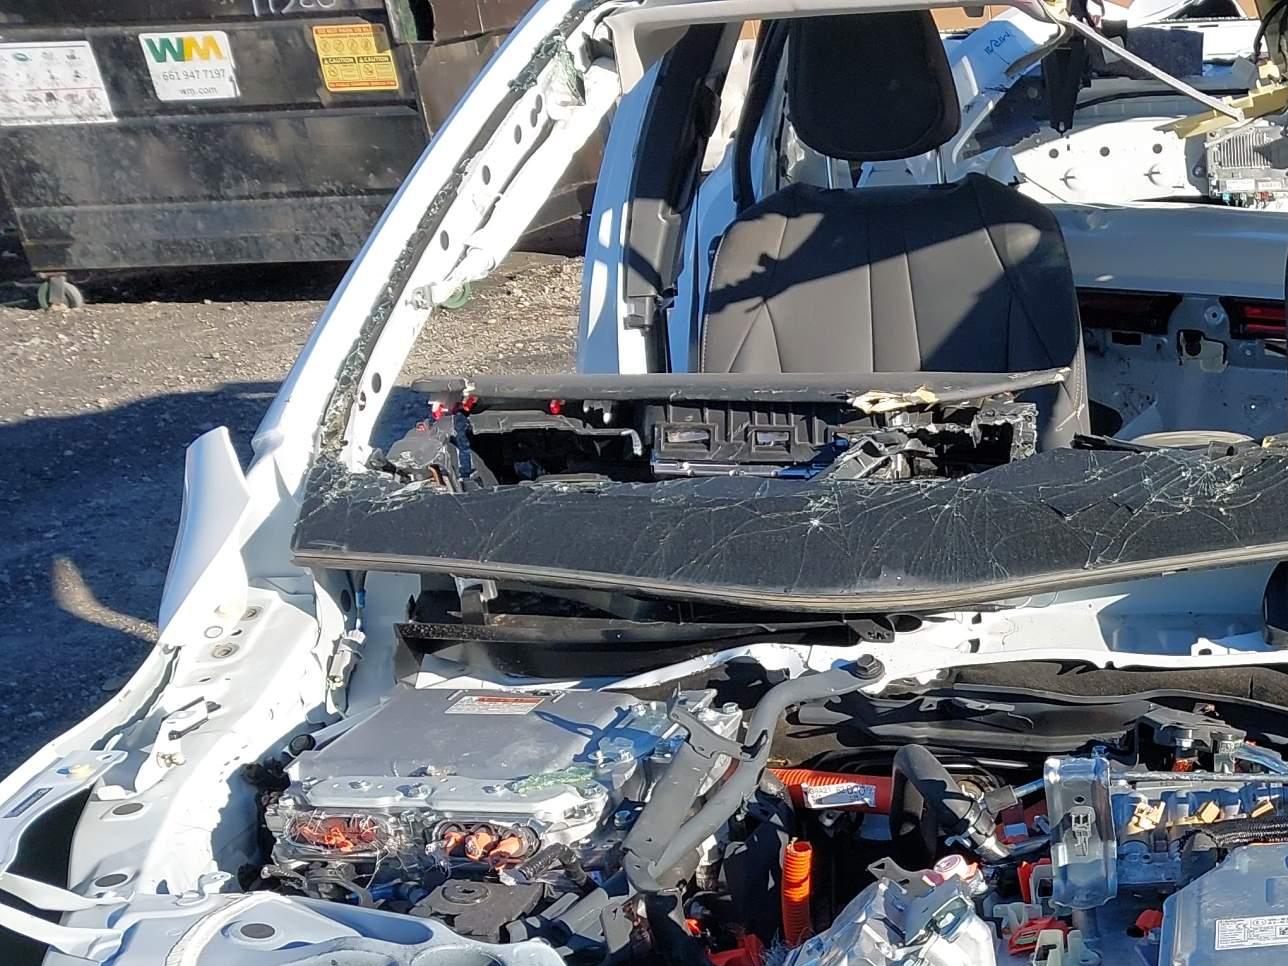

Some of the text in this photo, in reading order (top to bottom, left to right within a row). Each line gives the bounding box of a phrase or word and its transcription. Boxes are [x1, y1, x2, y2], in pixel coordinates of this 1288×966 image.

[144, 35, 224, 62] WM
[161, 69, 225, 81] 661 947 7197
